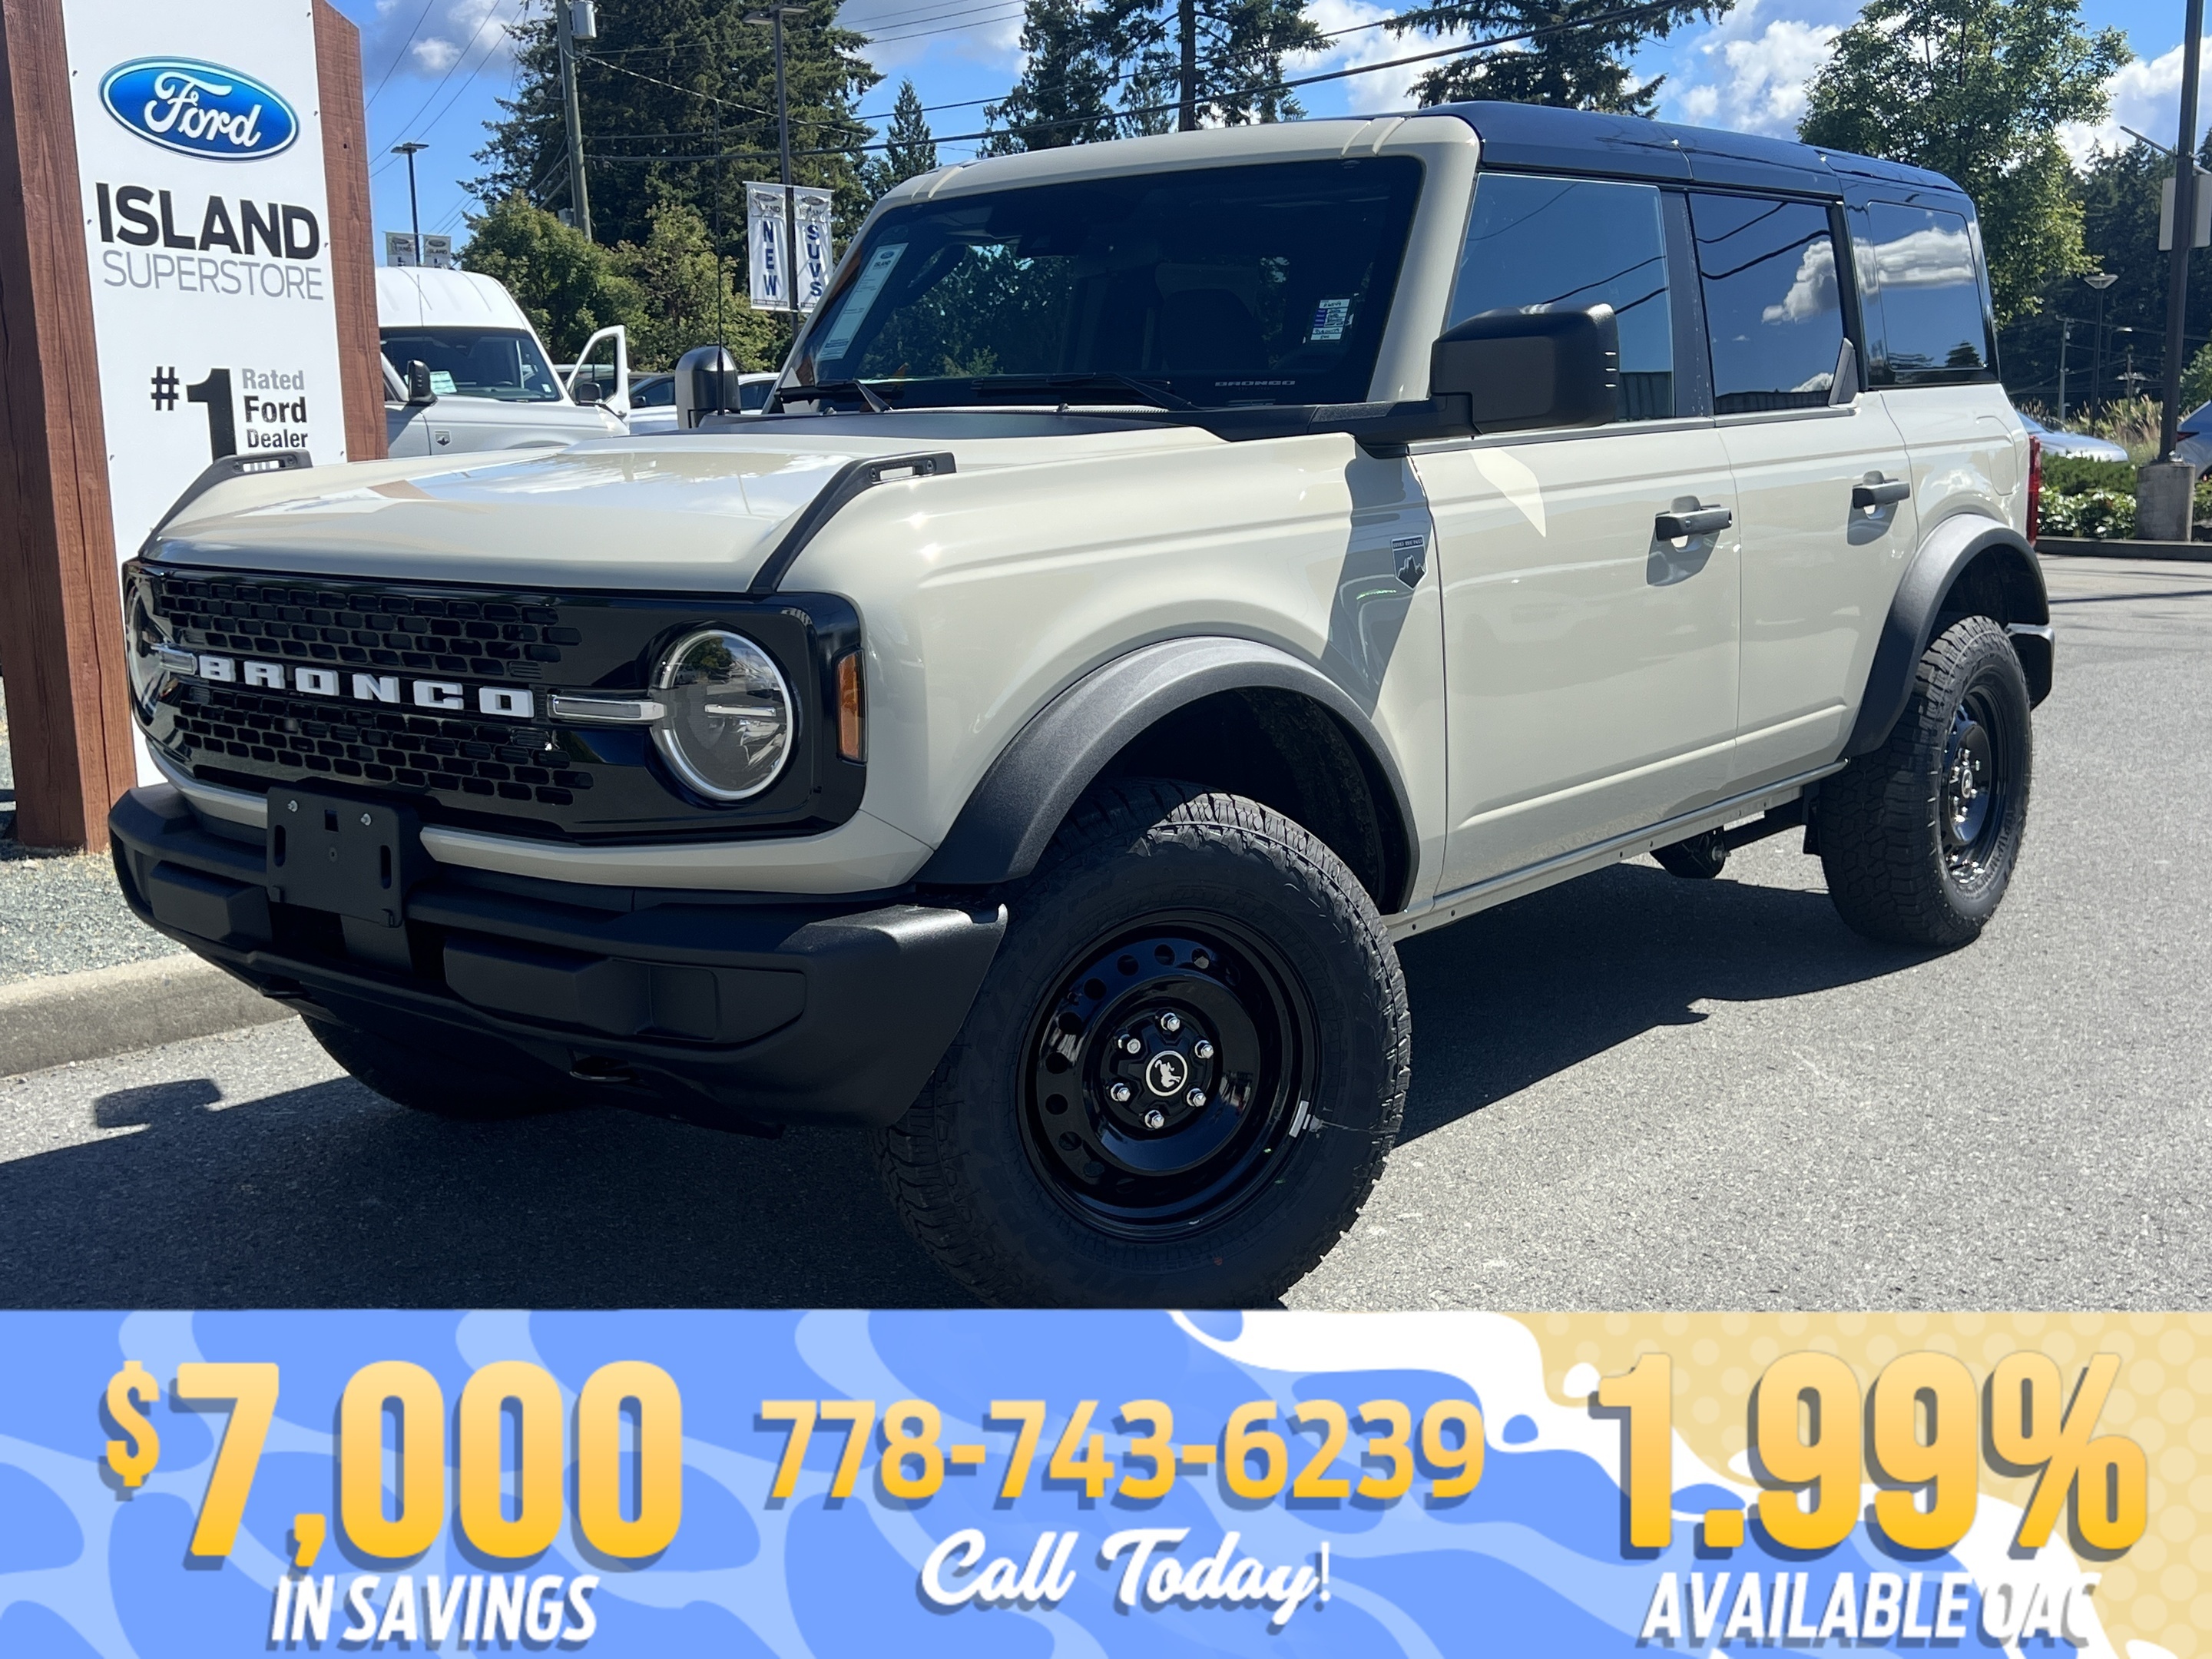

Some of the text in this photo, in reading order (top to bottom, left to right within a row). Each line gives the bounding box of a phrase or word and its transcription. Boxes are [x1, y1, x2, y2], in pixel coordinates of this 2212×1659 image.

[144, 71, 262, 147] Ford
[95, 182, 320, 260] ISLAND
[102, 250, 324, 300] SUPERSTORE
[763, 221, 778, 296] NEW
[807, 224, 823, 296] SUVS
[242, 368, 305, 390] Rated
[243, 395, 308, 423] Ford
[246, 429, 308, 448] Dealer
[198, 654, 535, 719] BRONCO
